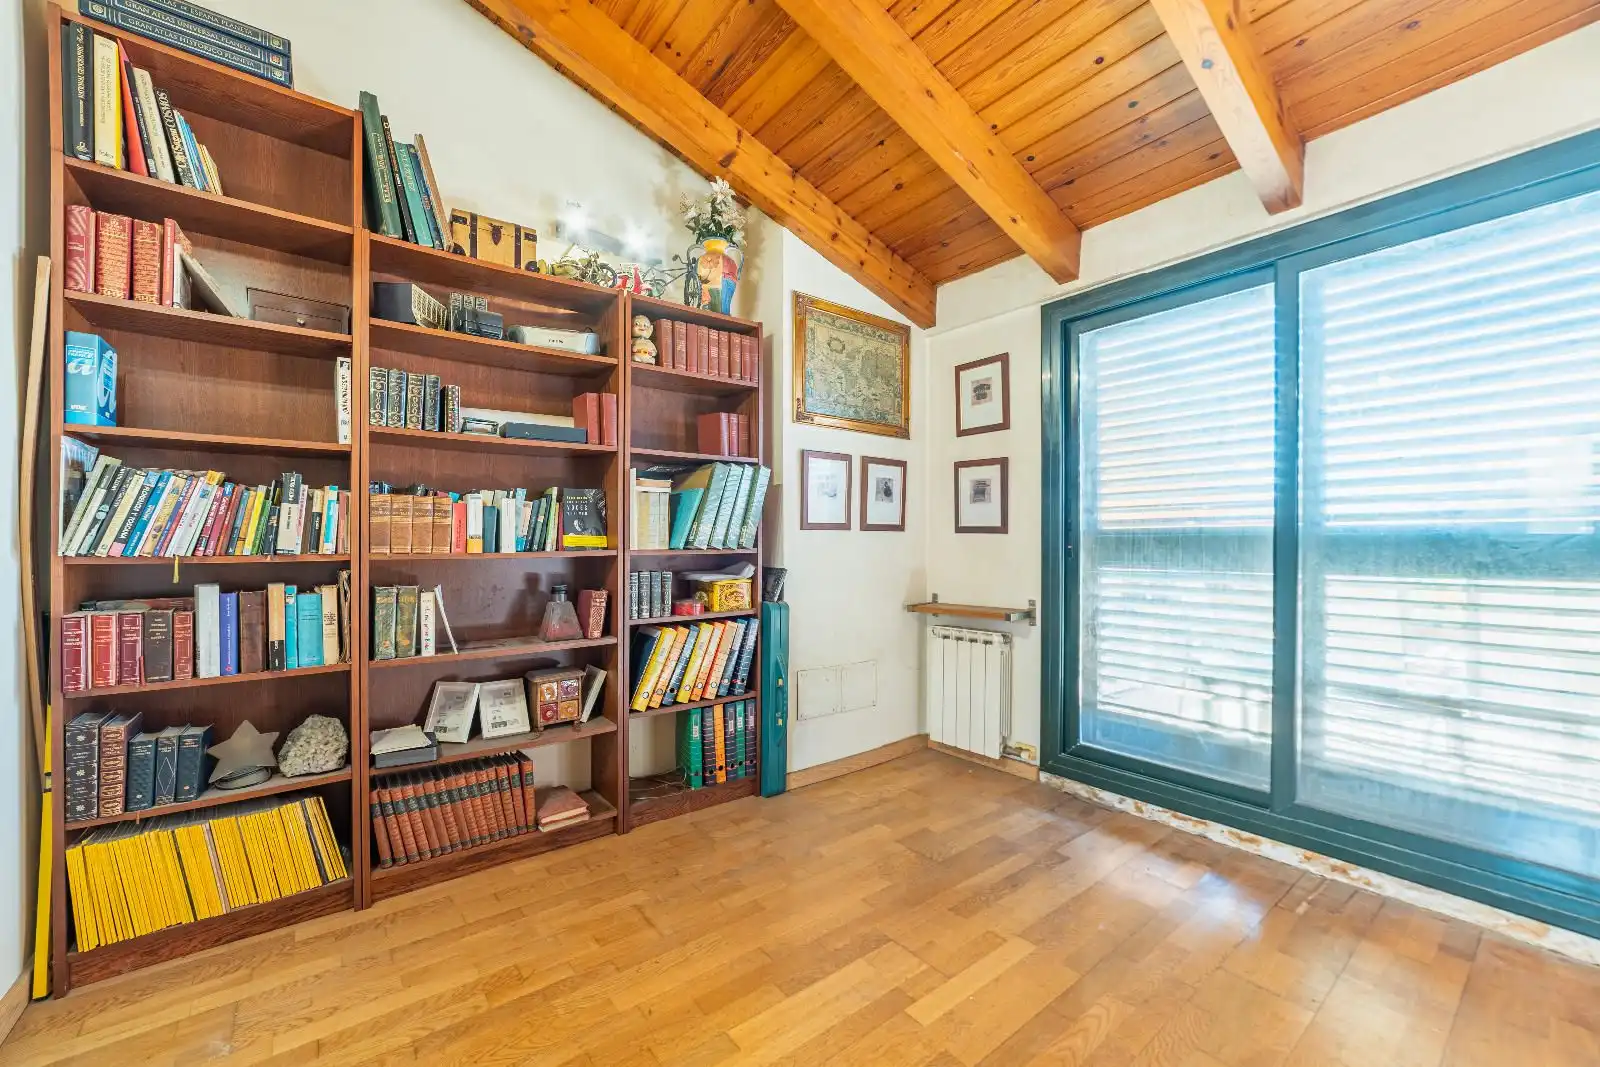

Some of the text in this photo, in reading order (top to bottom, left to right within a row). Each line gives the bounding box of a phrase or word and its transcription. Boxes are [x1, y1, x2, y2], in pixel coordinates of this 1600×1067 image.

[124, 1, 253, 53] GRAN ATLAS UNIVERSAL PLANETA
[127, 18, 153, 31] GRAN
[154, 28, 178, 40] ATLAS
[224, 52, 256, 66] PLANETA
[221, 19, 253, 36] PLANETA
[156, 89, 176, 128] COSMOS
[119, 516, 135, 539] TOSCANA
